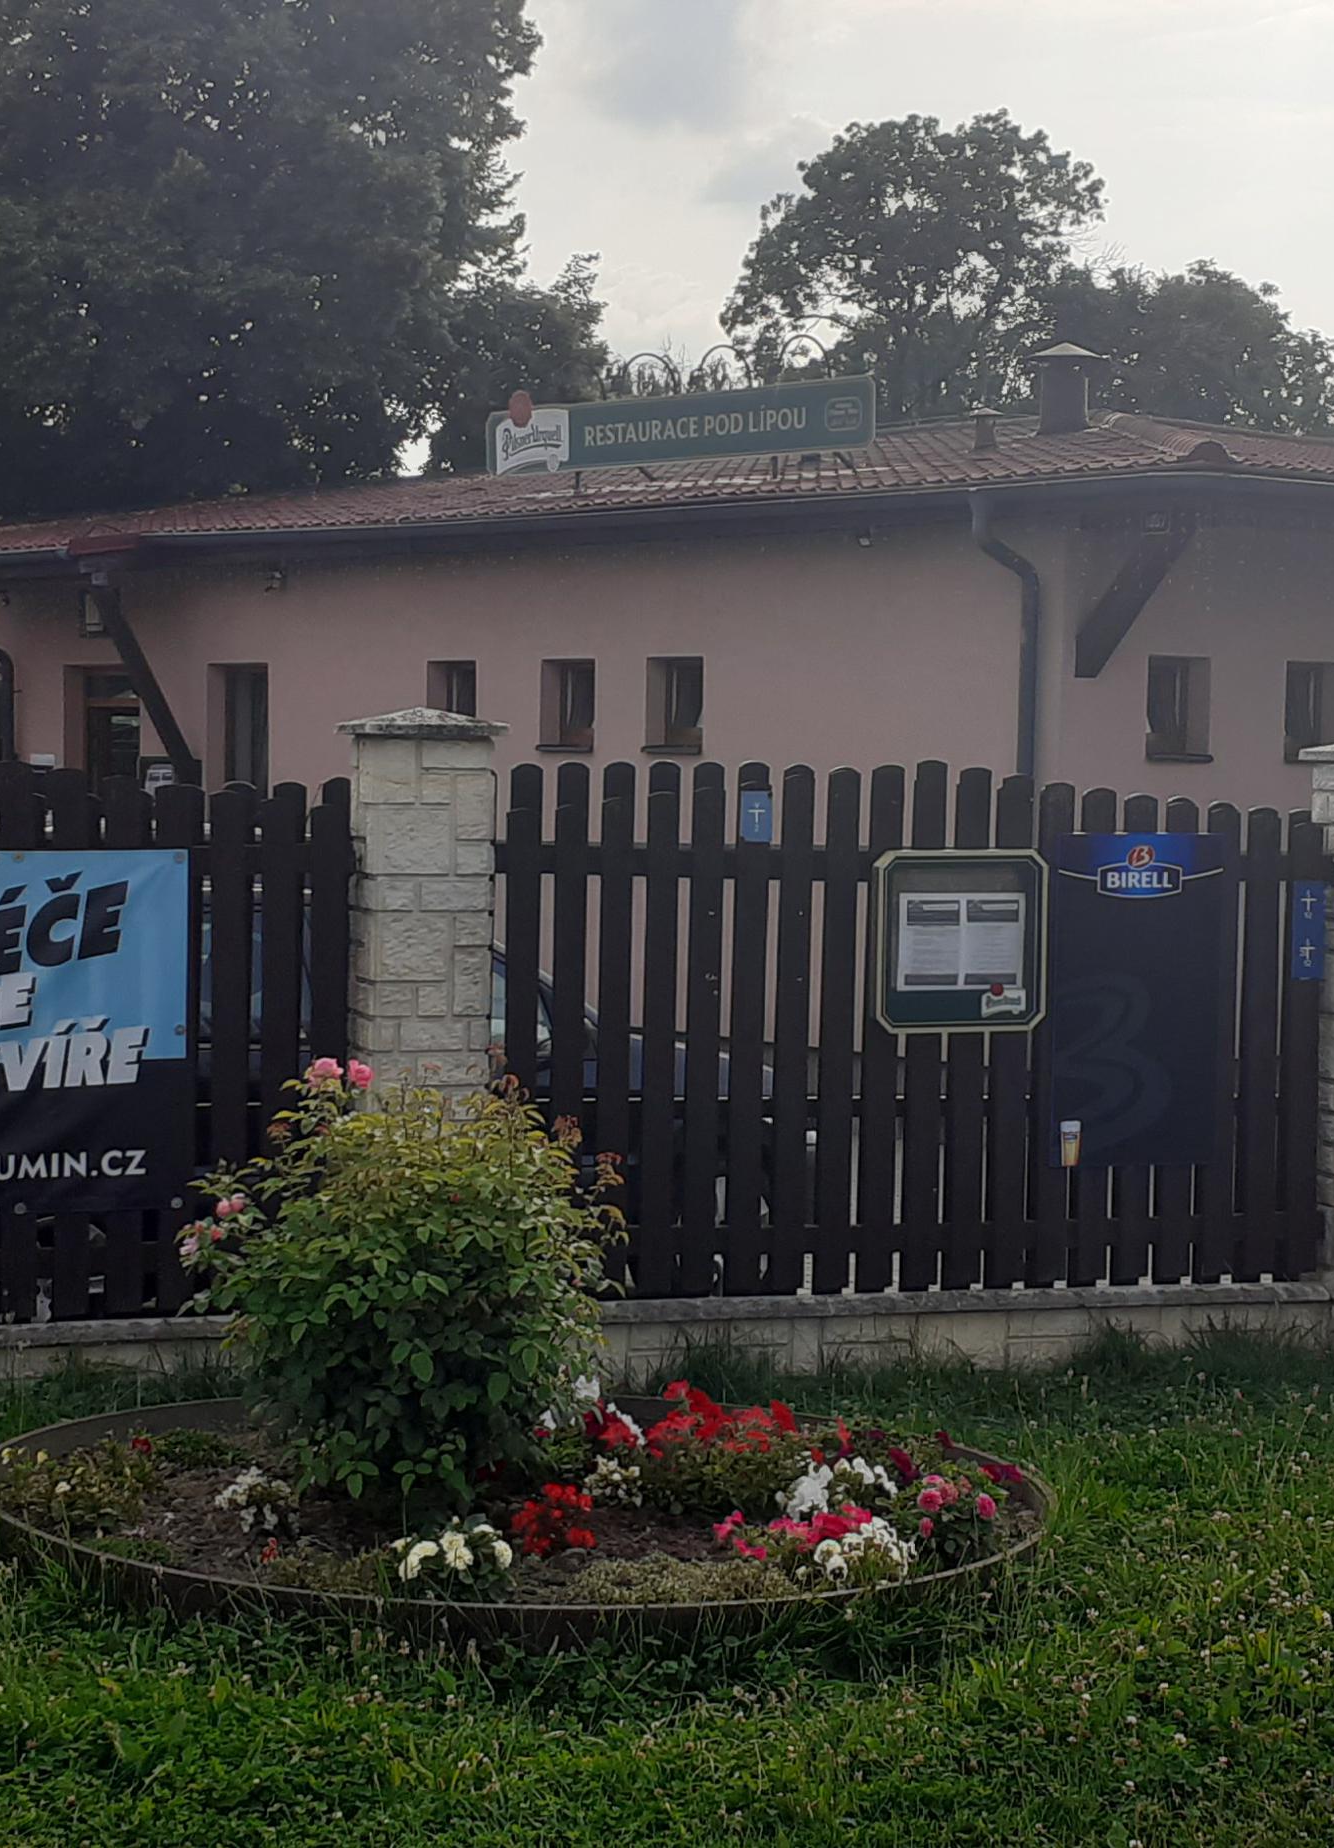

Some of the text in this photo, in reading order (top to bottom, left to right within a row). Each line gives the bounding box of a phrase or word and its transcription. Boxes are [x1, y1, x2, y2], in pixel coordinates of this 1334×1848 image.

[584, 417, 699, 447] RESTAURACE
[704, 412, 743, 436] POD
[748, 405, 806, 432] LÍPOU
[1107, 871, 1173, 888] BIRELL
